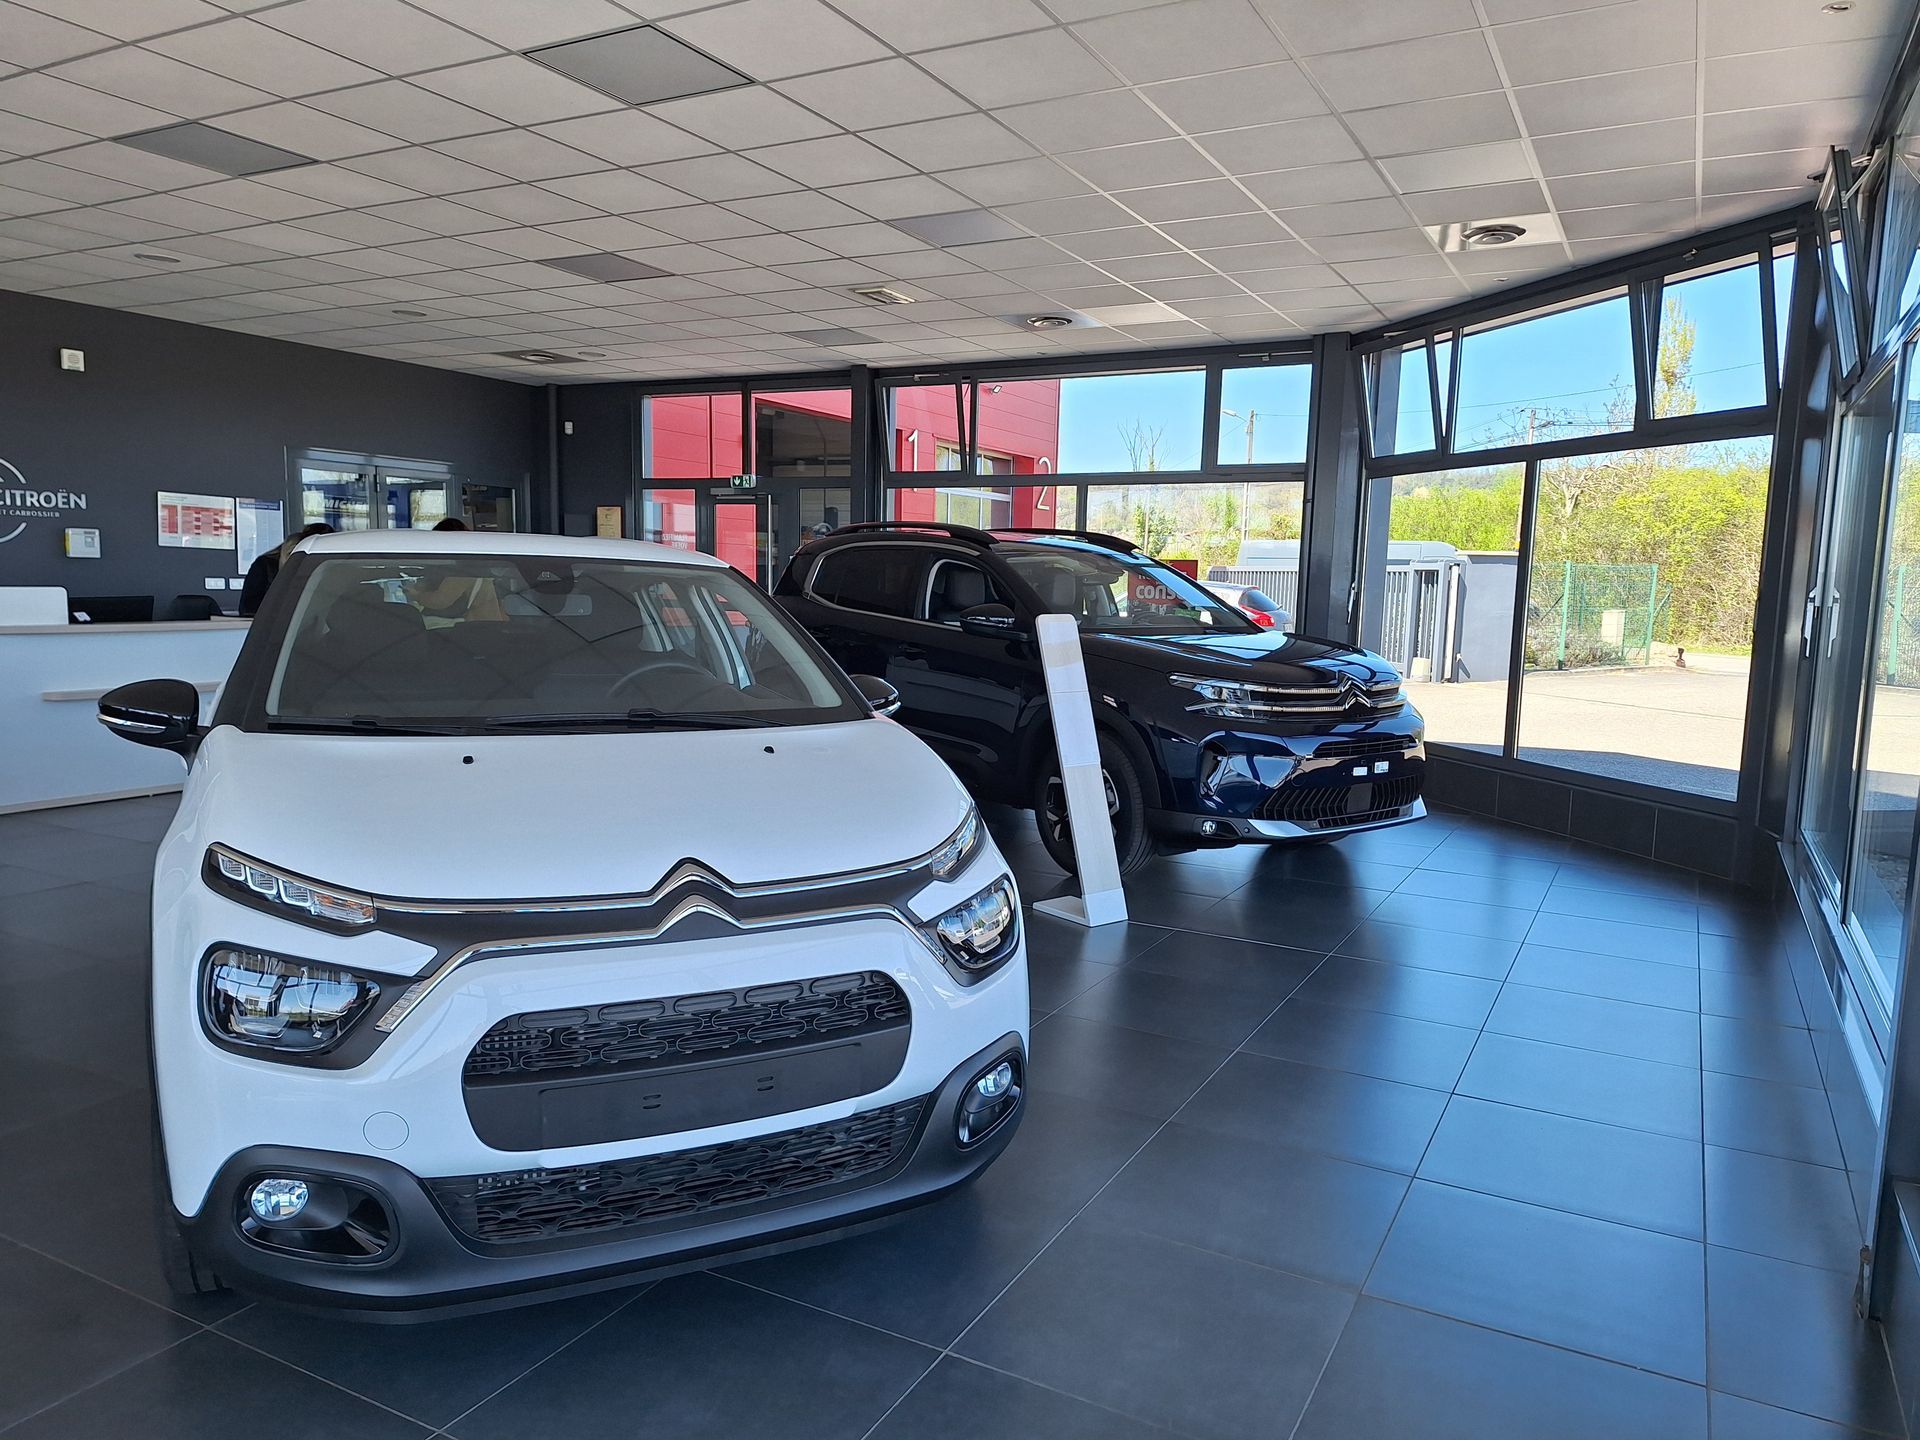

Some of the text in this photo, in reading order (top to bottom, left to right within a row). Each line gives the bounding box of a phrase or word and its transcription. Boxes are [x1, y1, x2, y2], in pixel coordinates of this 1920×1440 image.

[908, 429, 918, 492] 1
[1036, 457, 1052, 510] 2
[9, 509, 60, 518] CARROSSIER
[1136, 585, 1182, 600] cons
